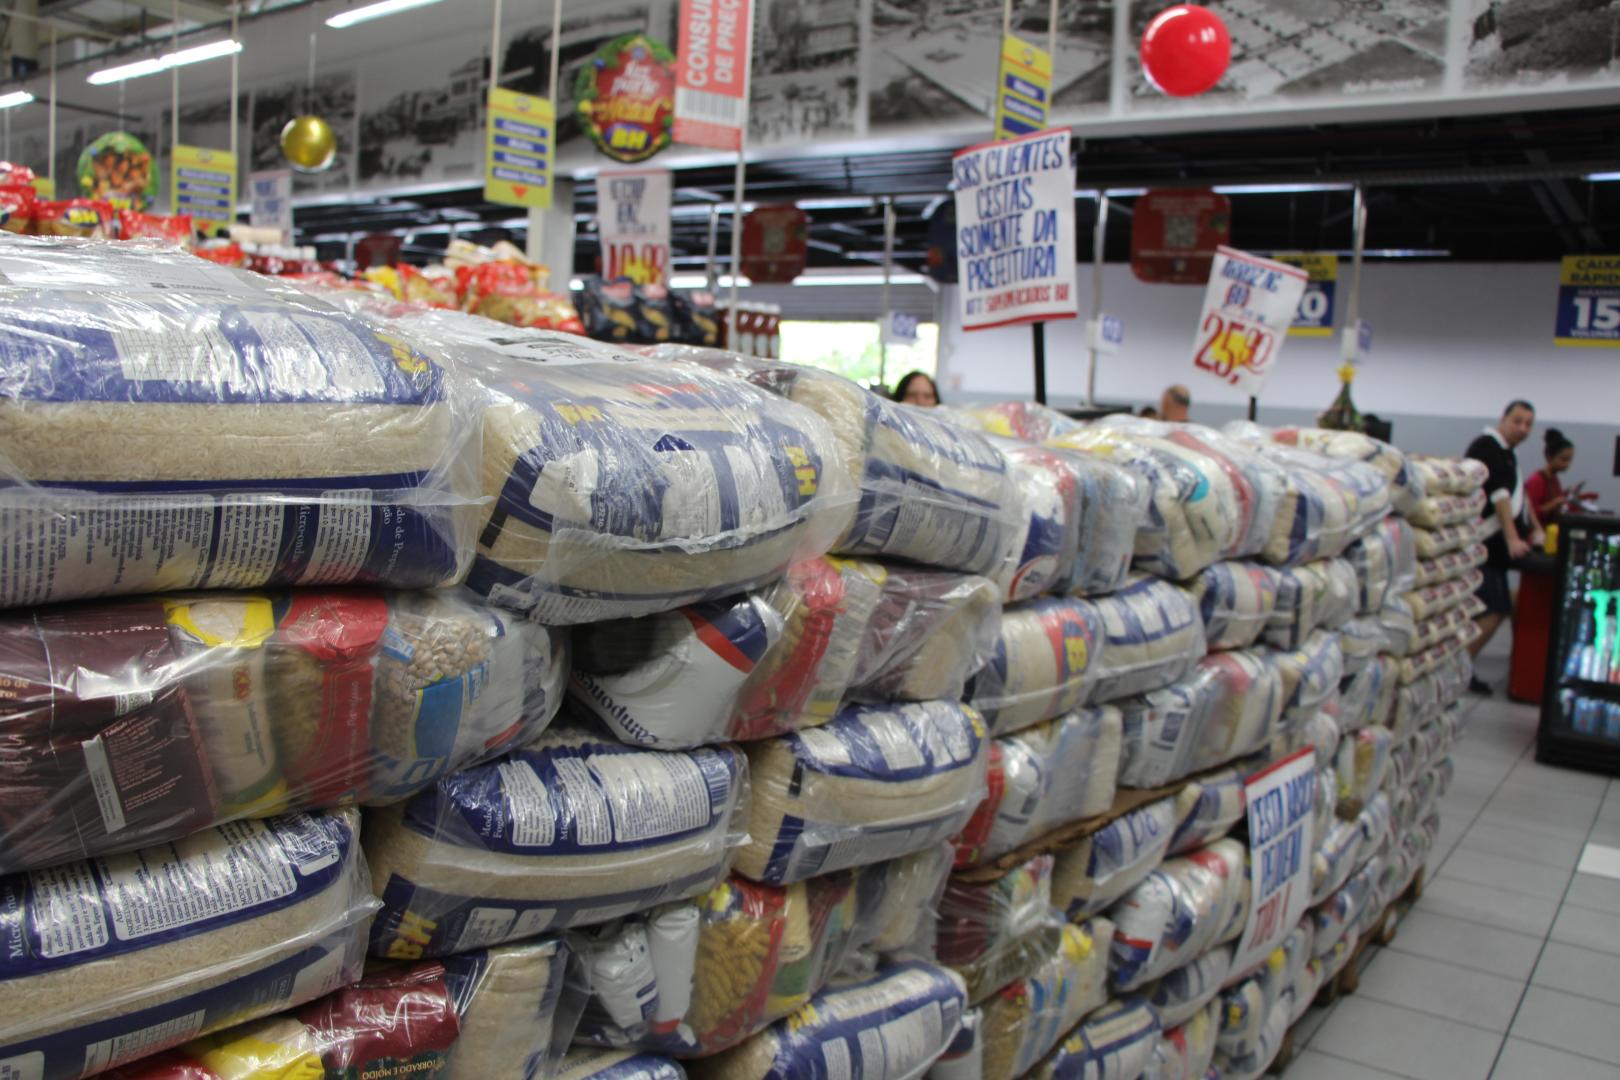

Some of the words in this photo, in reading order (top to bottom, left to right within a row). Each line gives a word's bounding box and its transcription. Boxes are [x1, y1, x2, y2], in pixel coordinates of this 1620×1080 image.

[713, 54, 735, 83] DE
[610, 128, 648, 150] BH
[985, 136, 1065, 180] CLIENTES
[977, 178, 1034, 220] CESTAS
[960, 214, 1023, 258] SOMENTE
[1033, 210, 1059, 243] DA
[967, 246, 1058, 292] PREFEITURA
[1573, 297, 1620, 330] 15
[387, 911, 438, 960] BH
